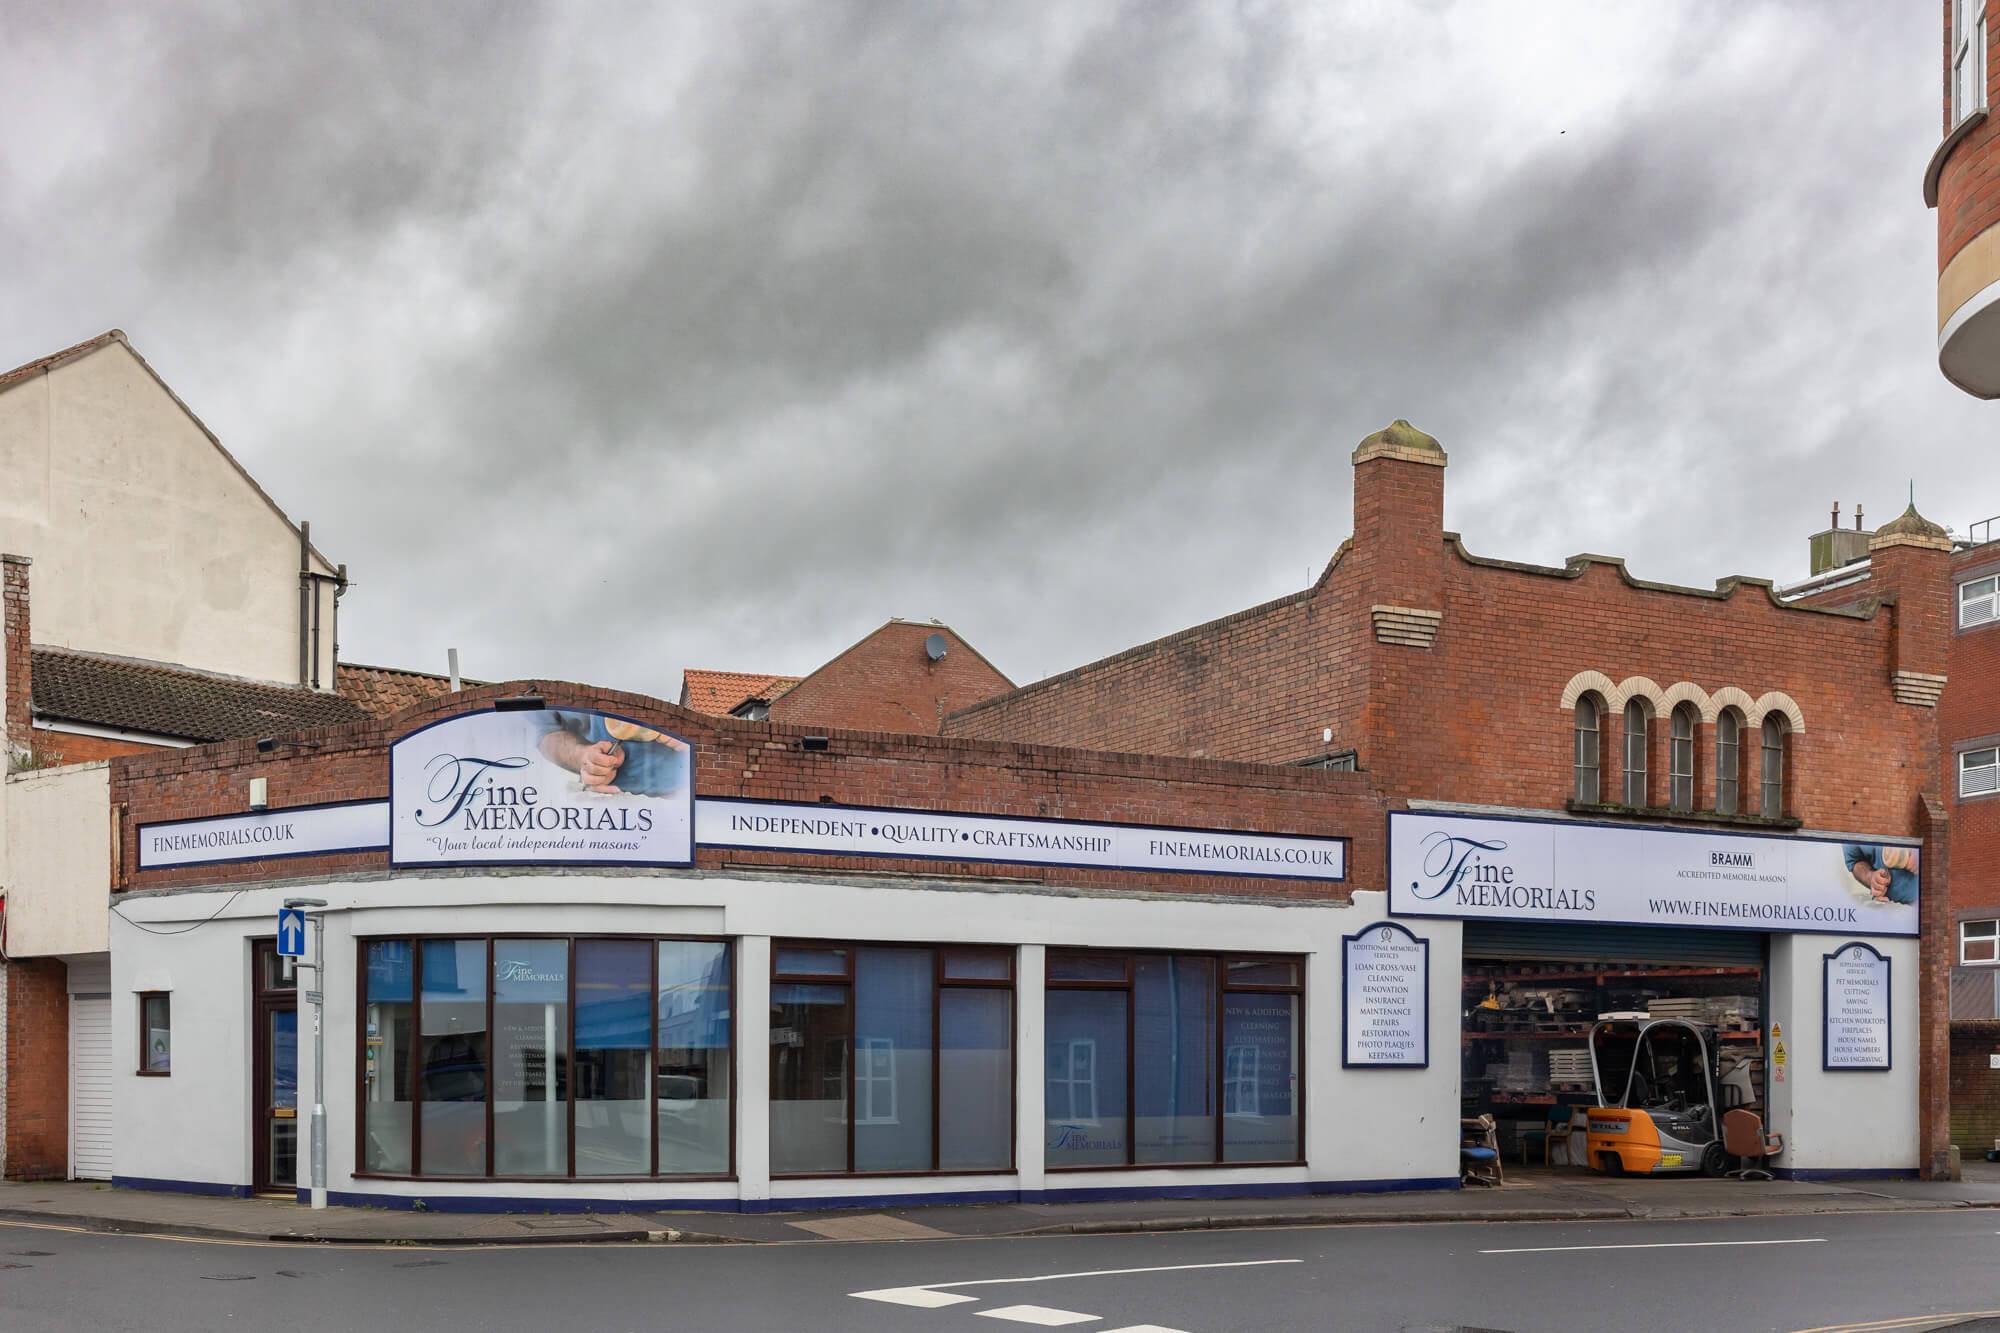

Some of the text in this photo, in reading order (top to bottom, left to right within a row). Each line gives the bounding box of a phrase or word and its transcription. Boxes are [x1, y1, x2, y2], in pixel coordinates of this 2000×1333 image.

[415, 753, 538, 827] Fine
[464, 807, 652, 831] MEMORIALS
[153, 824, 295, 853] FINEMEMORIALS.CO.UK
[470, 836, 503, 851] local
[506, 836, 584, 853] independent
[731, 815, 1111, 853] INDEPENDENT QUALITY CRAFTSMANSHIP
[1149, 840, 1334, 866] FINEMEMORIALS.CO.UK
[1711, 853, 1753, 867] BRAMM
[1411, 831, 1514, 900] Fine
[1678, 870, 1786, 883] ACCREDITED MEMORIAL MASONS
[1457, 884, 1595, 911] MEMORIALS
[1648, 898, 1857, 923] WWW.FINEMEMORIALS.CO.UK
[496, 960, 533, 981] Fine
[512, 974, 564, 982] MEMORIALS
[1385, 1041, 1414, 1049] PLAQUES
